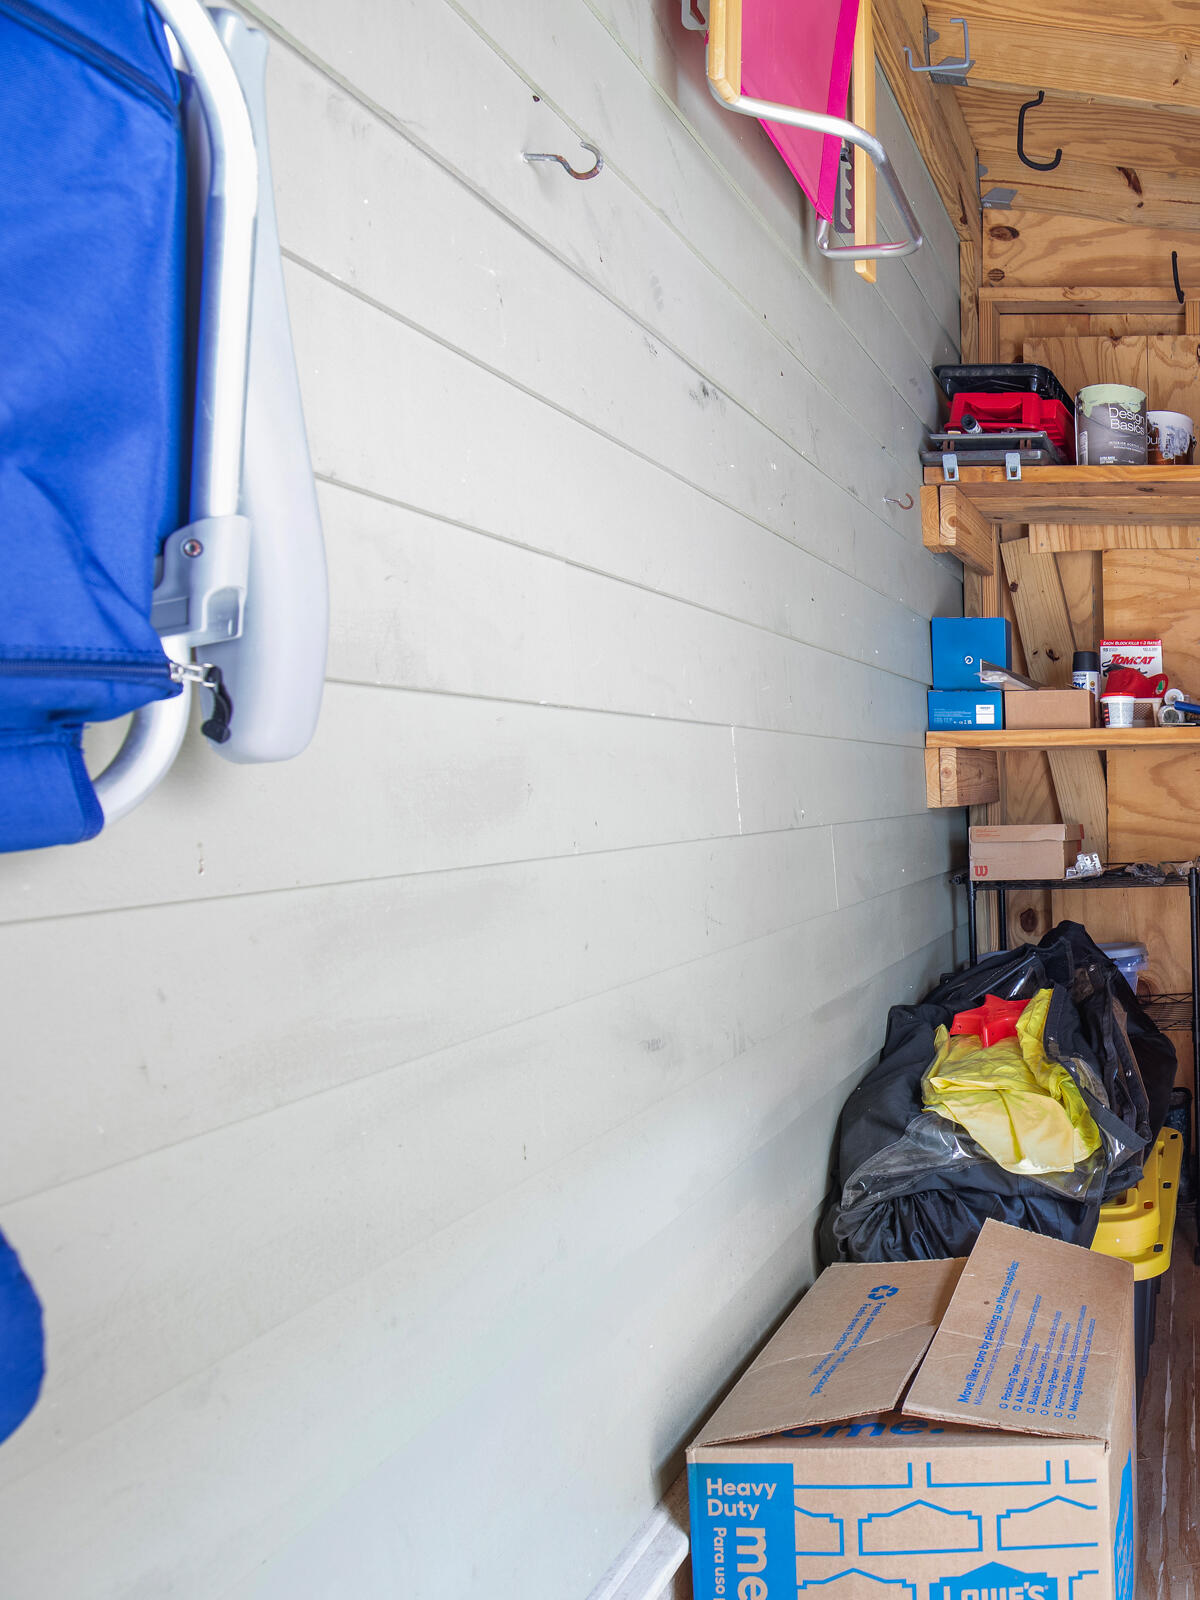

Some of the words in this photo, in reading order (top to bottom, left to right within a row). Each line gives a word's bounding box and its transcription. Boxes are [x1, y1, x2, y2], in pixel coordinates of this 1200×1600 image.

[1109, 407, 1145, 425] Design
[1110, 418, 1146, 436] Basics
[1111, 654, 1155, 665] TOMCAT
[996, 1286, 1010, 1303] these
[994, 1304, 1004, 1314] up
[984, 1314, 1002, 1341] picking
[976, 1350, 987, 1363] pro
[978, 1341, 992, 1350] by
[965, 1368, 980, 1382] like
[1008, 1363, 1021, 1378] Tape
[1033, 1362, 1048, 1384] Cushion
[1047, 1367, 1060, 1384] Paper
[1073, 1366, 1086, 1390] Blankets
[957, 1382, 976, 1404] Move
[1001, 1376, 1018, 1402] Packing
[1016, 1376, 1030, 1398] Marker
[1027, 1385, 1042, 1406] Bubble
[1041, 1383, 1057, 1408] Packing
[1055, 1383, 1069, 1410] Furniture
[1068, 1389, 1083, 1412] Moving
[706, 1478, 777, 1500] Heavy
[707, 1499, 760, 1521] Duty
[713, 1527, 727, 1564] Para
[715, 1567, 725, 1595] uso
